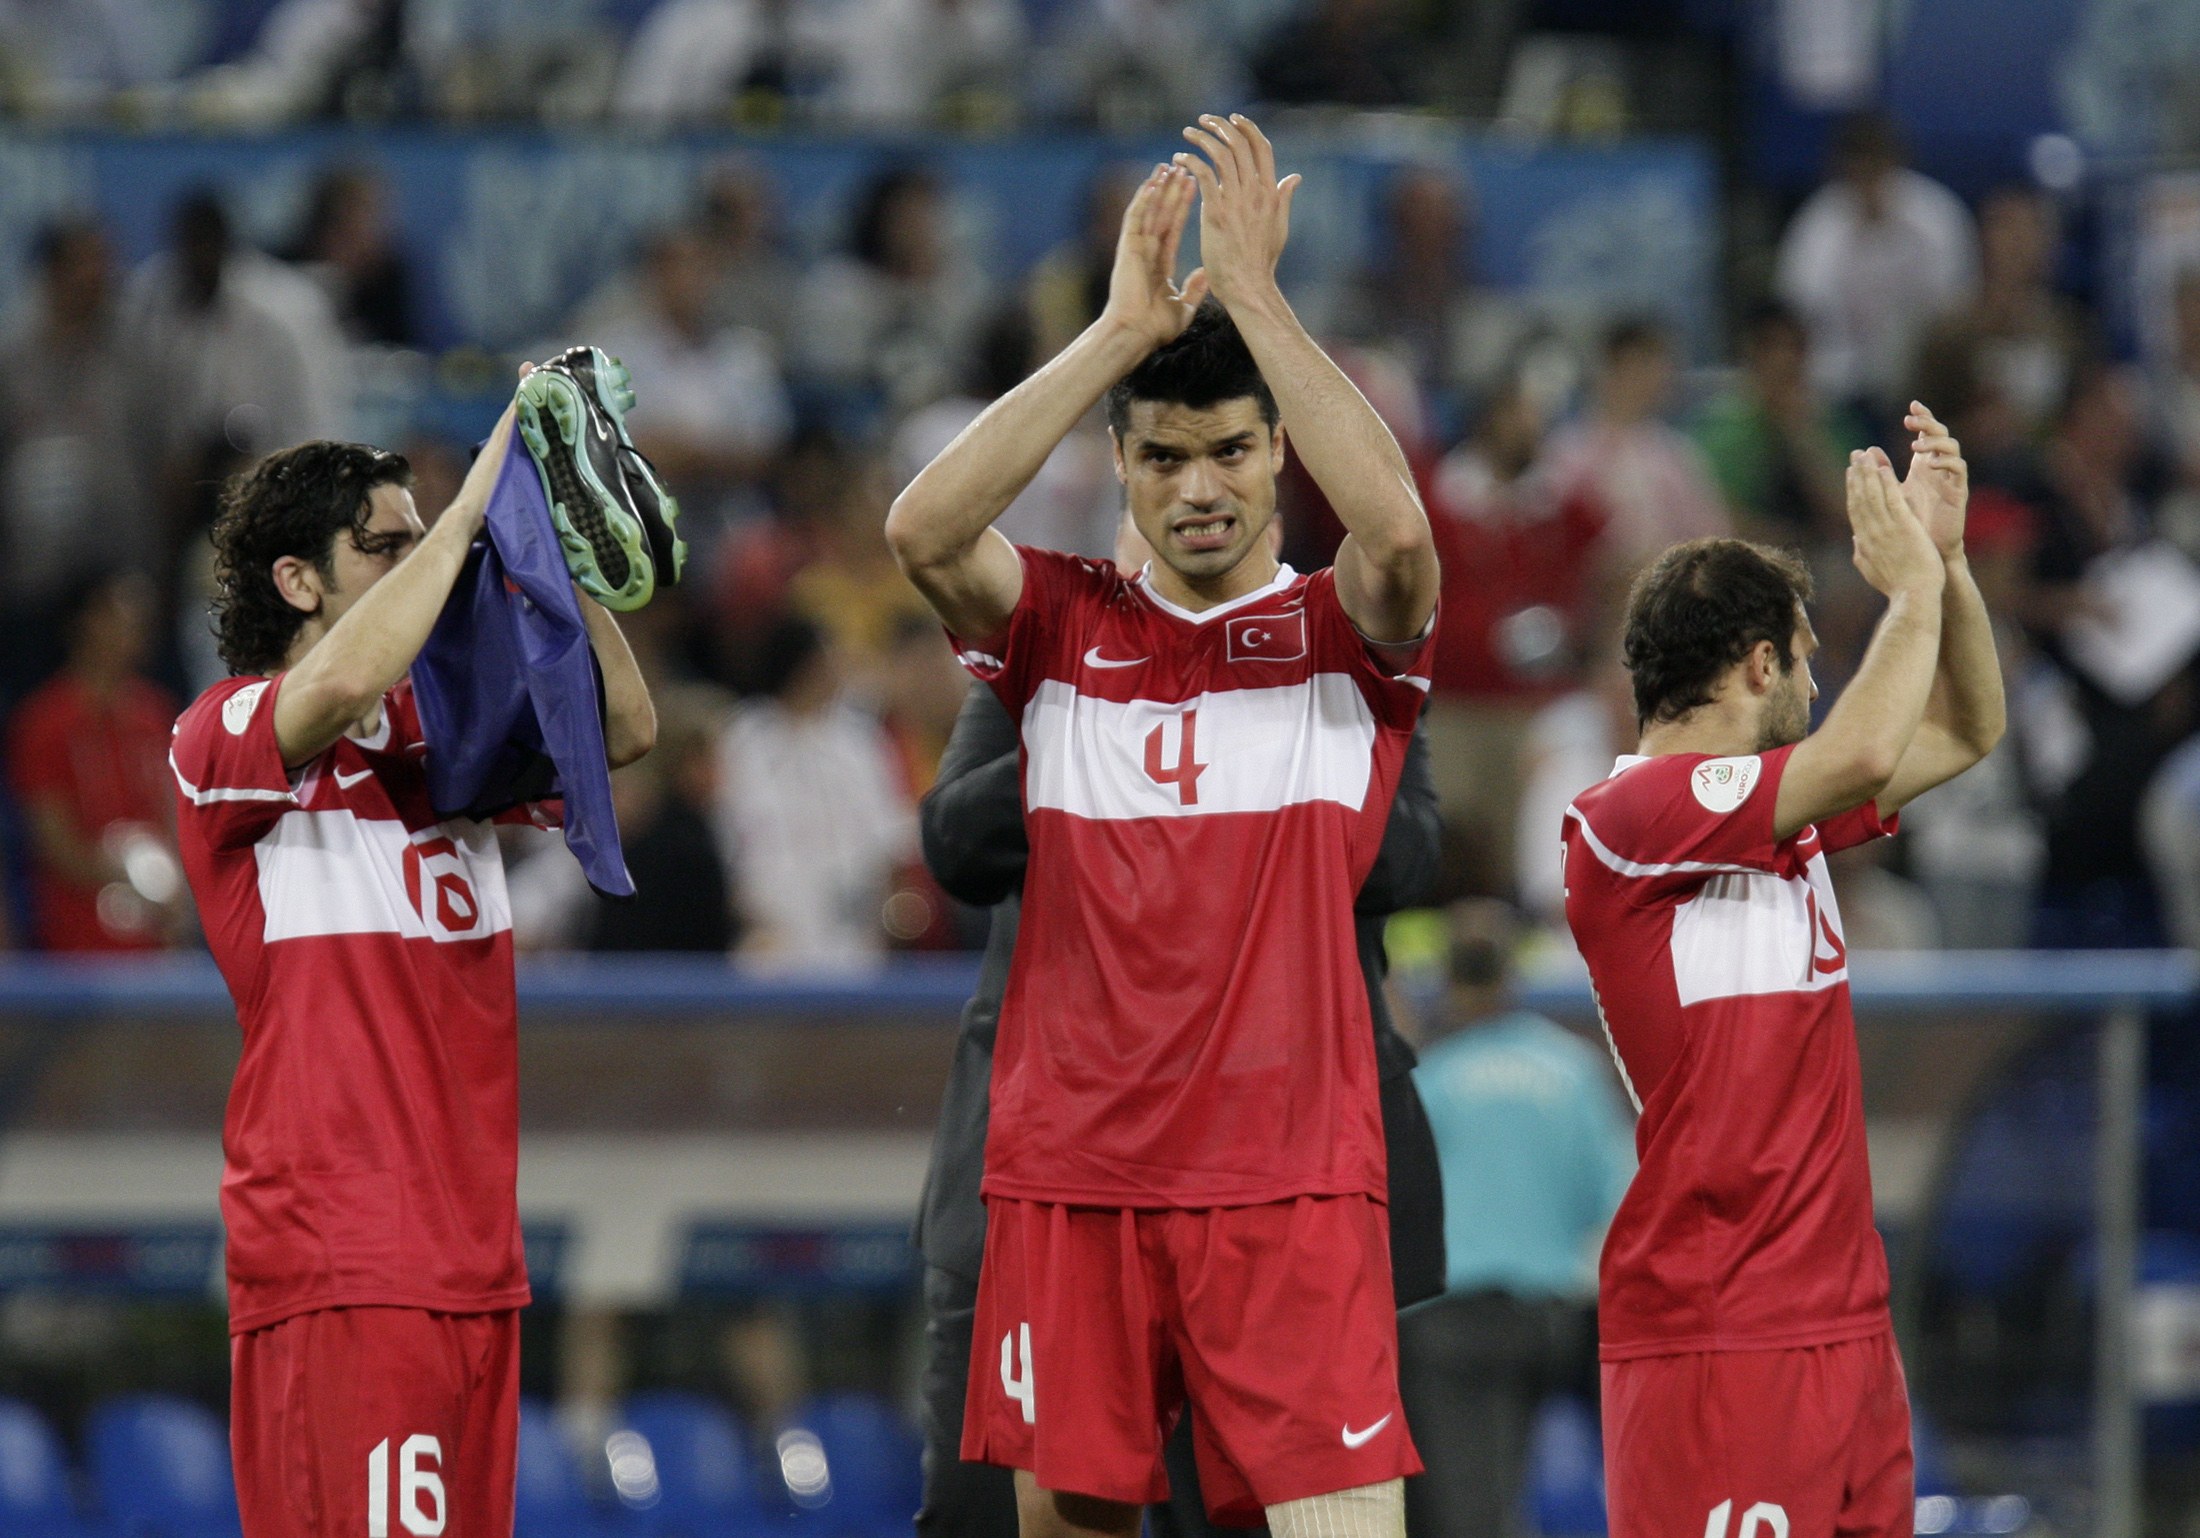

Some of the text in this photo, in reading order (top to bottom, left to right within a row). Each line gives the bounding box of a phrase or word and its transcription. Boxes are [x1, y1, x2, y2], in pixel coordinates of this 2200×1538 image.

[1143, 708, 1210, 805] 4
[401, 836, 479, 932] 16
[1000, 1322, 1035, 1423] 4
[368, 1433, 446, 1538] 16
